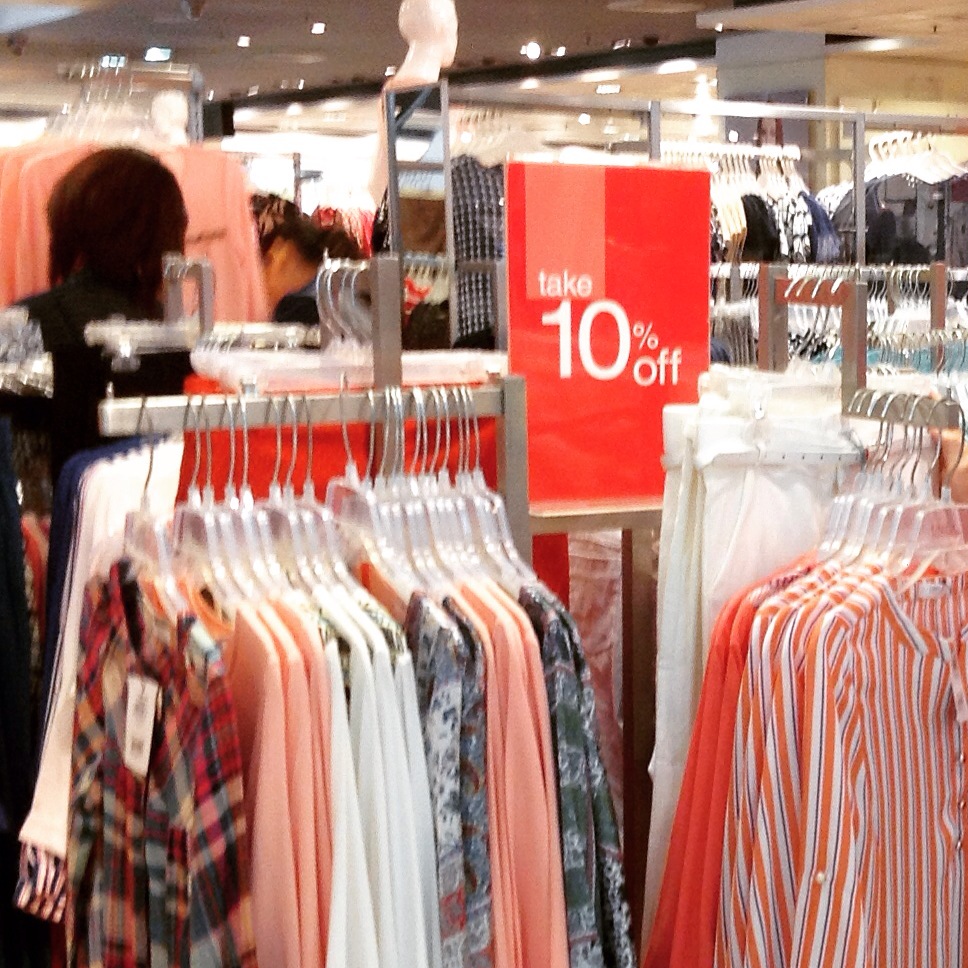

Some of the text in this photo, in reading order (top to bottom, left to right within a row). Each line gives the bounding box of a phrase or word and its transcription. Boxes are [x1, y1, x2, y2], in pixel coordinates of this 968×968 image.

[538, 269, 593, 298] take
[541, 299, 682, 387] 10% off
